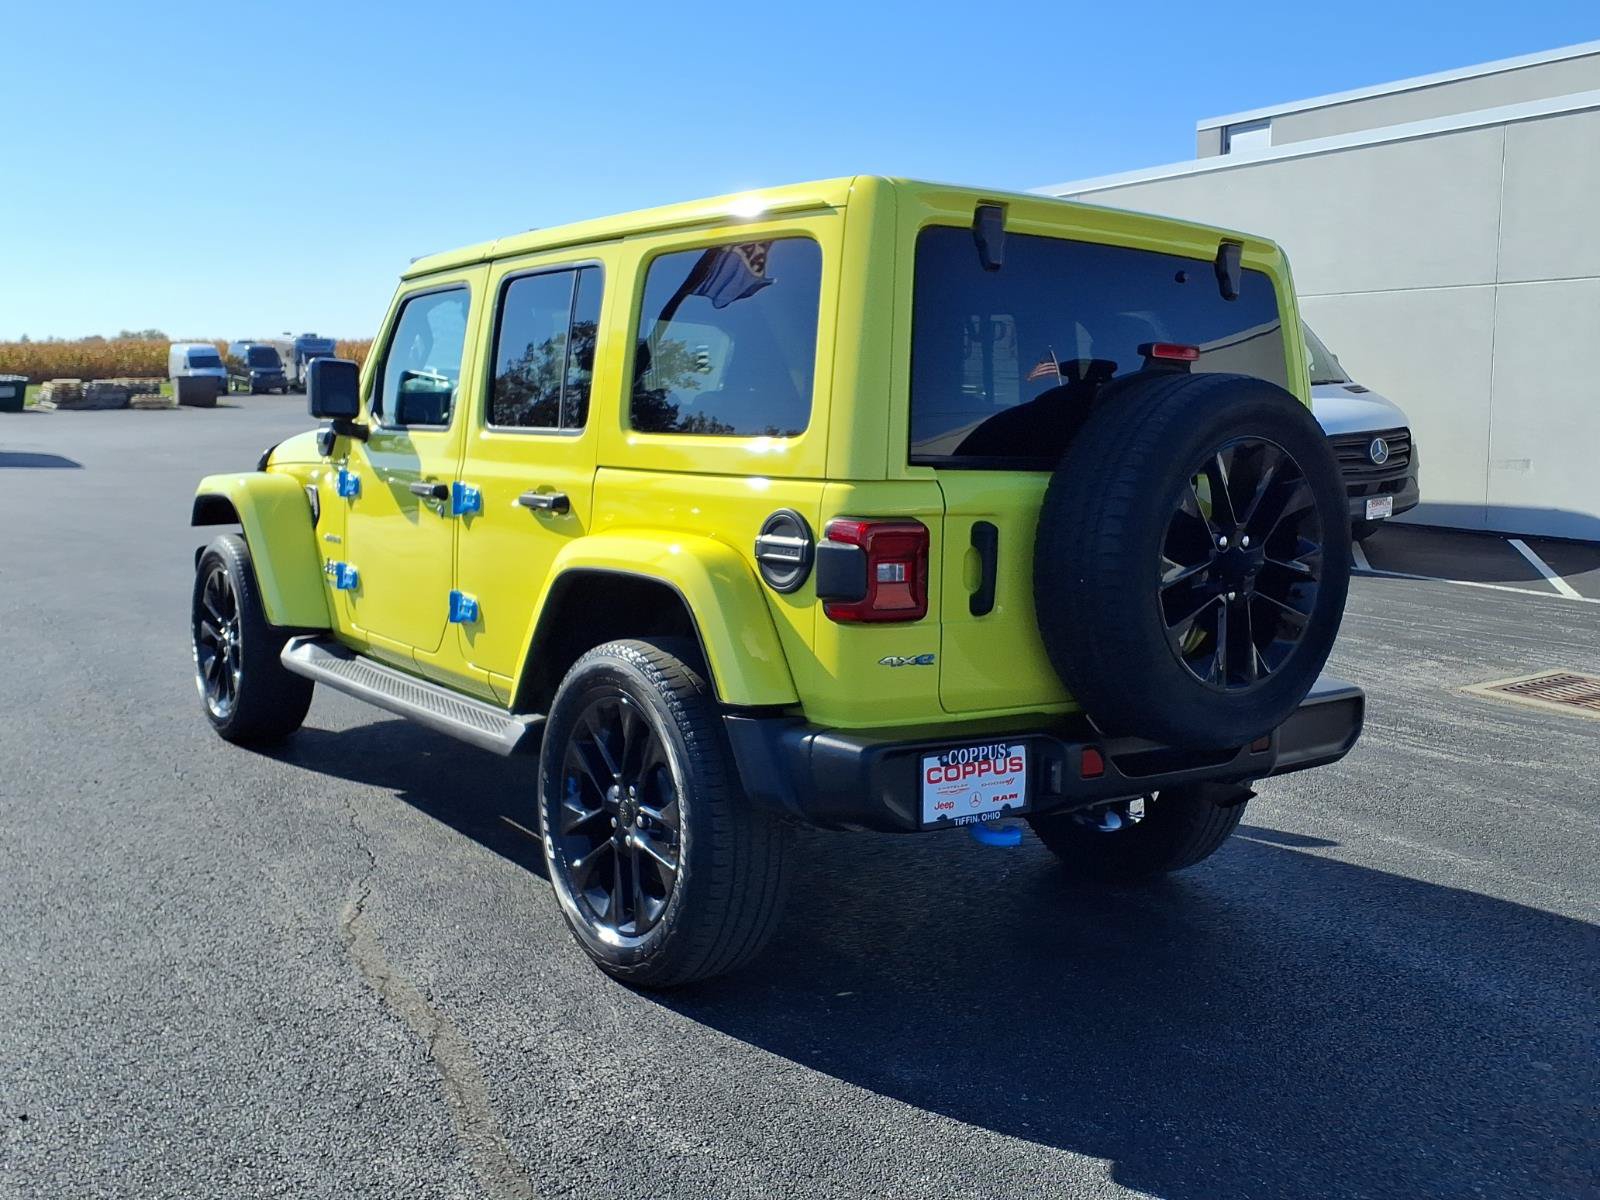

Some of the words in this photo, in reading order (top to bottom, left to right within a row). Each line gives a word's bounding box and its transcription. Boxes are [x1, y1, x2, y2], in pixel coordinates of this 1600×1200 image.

[949, 744, 1006, 766] COPPUS
[927, 756, 1023, 784] COPPUS
[992, 793, 1018, 803] RAM
[934, 801, 955, 811] Jeep
[981, 811, 1001, 821] OHIO
